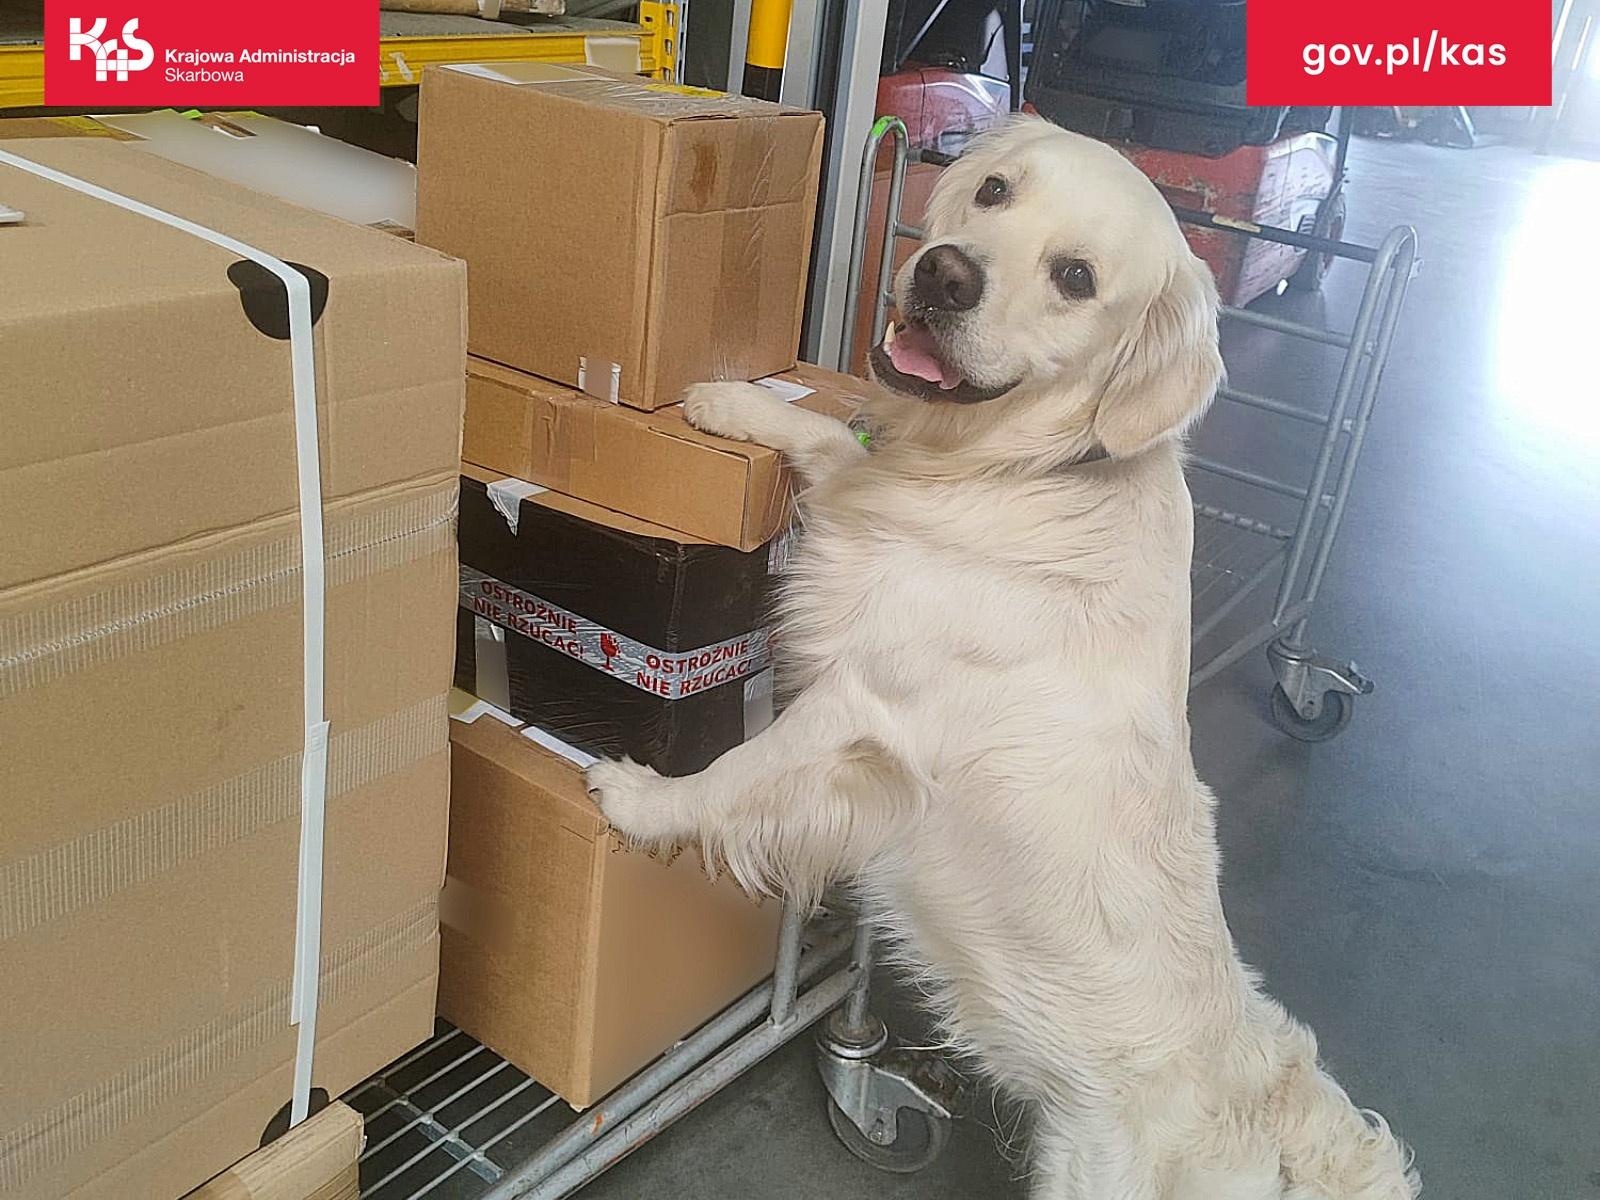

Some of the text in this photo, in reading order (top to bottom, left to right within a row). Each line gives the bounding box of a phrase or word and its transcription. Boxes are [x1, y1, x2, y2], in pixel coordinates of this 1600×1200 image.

[475, 597, 501, 620] NIE
[481, 580, 577, 634] OSTROŻNIE
[637, 671, 671, 696] NIE
